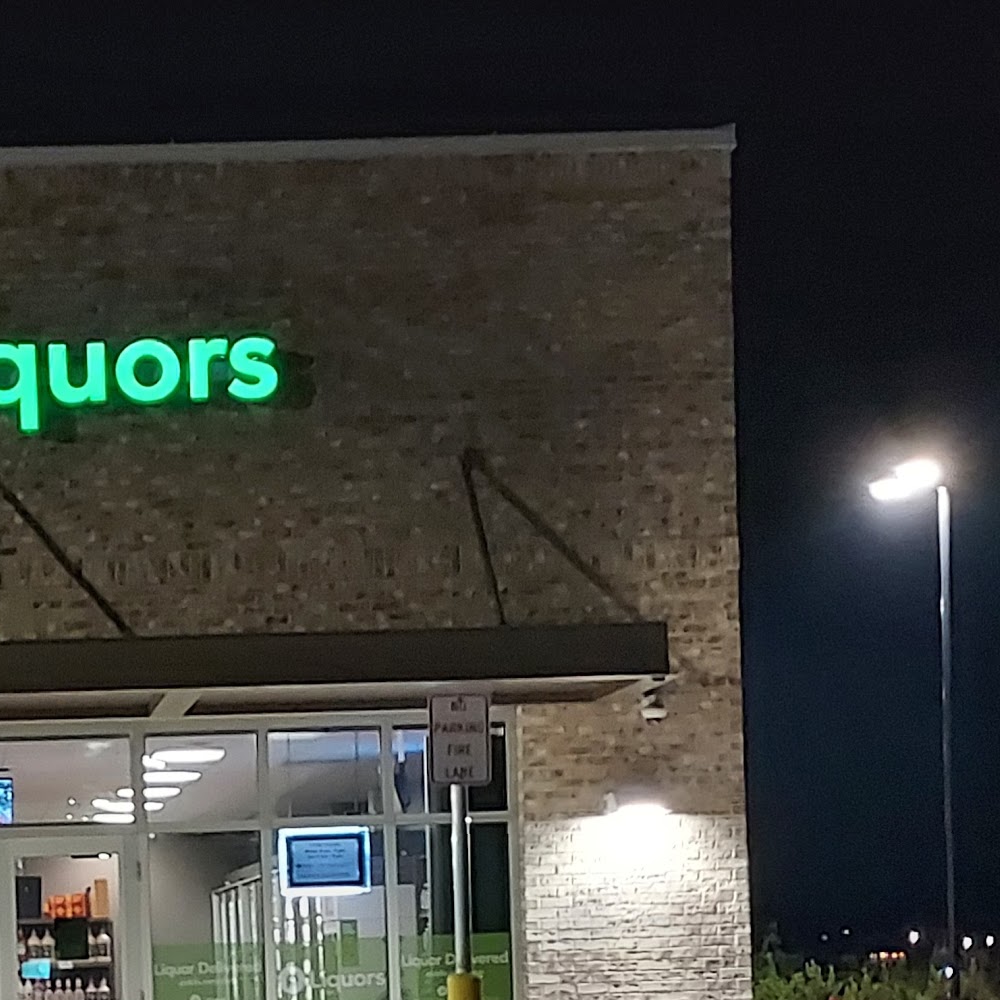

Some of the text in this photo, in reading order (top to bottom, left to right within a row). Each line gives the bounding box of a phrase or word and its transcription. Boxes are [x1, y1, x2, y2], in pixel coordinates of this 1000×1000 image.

[434, 721, 484, 733] PARKING
[447, 743, 472, 756] FIRE
[445, 766, 474, 779] LANE
[311, 970, 385, 992] Liquors
